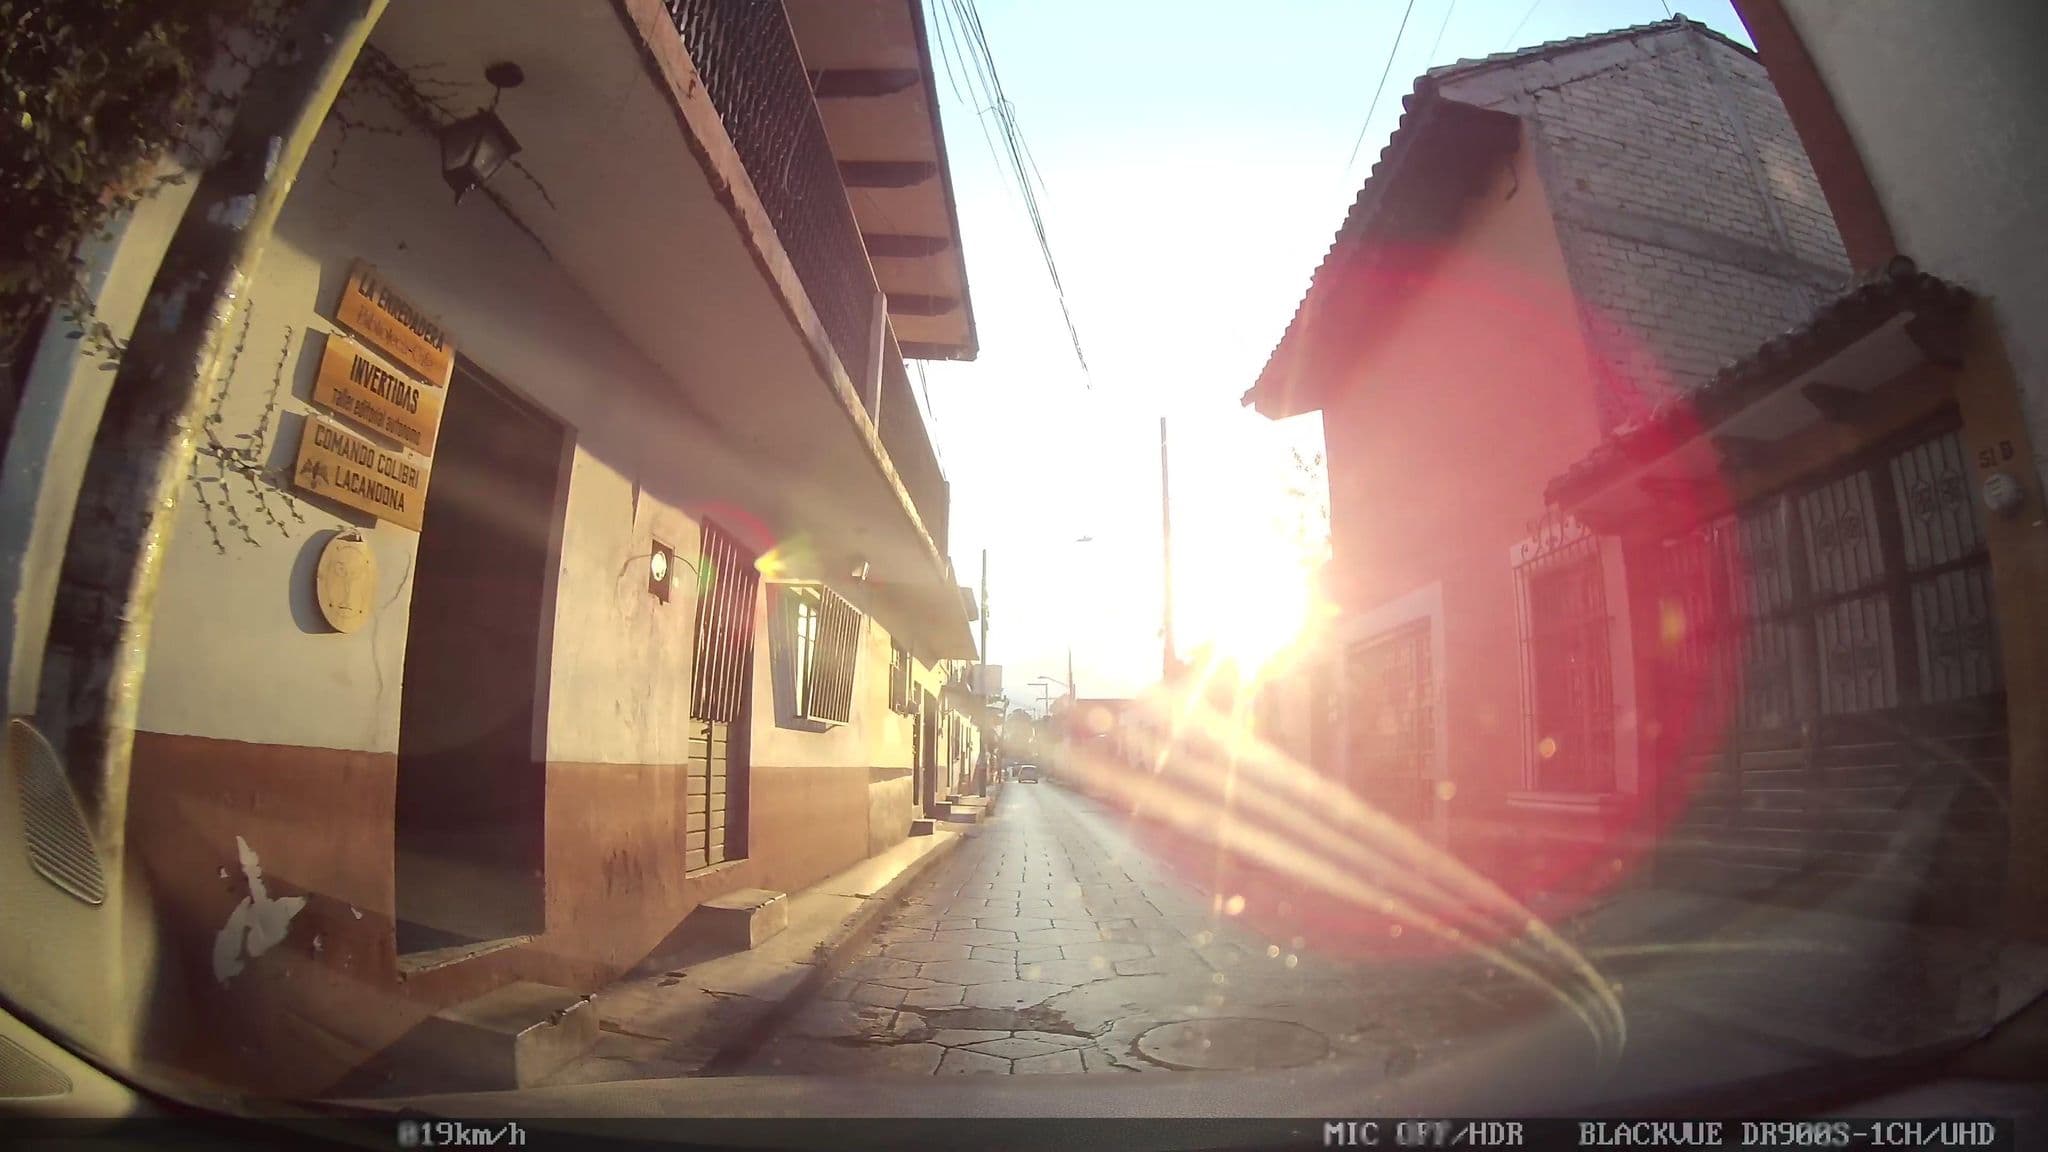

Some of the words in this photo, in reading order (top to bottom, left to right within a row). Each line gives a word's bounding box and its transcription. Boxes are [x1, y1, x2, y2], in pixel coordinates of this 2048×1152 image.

[357, 272, 374, 302] LA
[350, 354, 420, 415] INVERTIDAS
[314, 423, 375, 469] COMANDO
[376, 452, 420, 490] COLIBRI
[334, 465, 406, 513] LACANDONA
